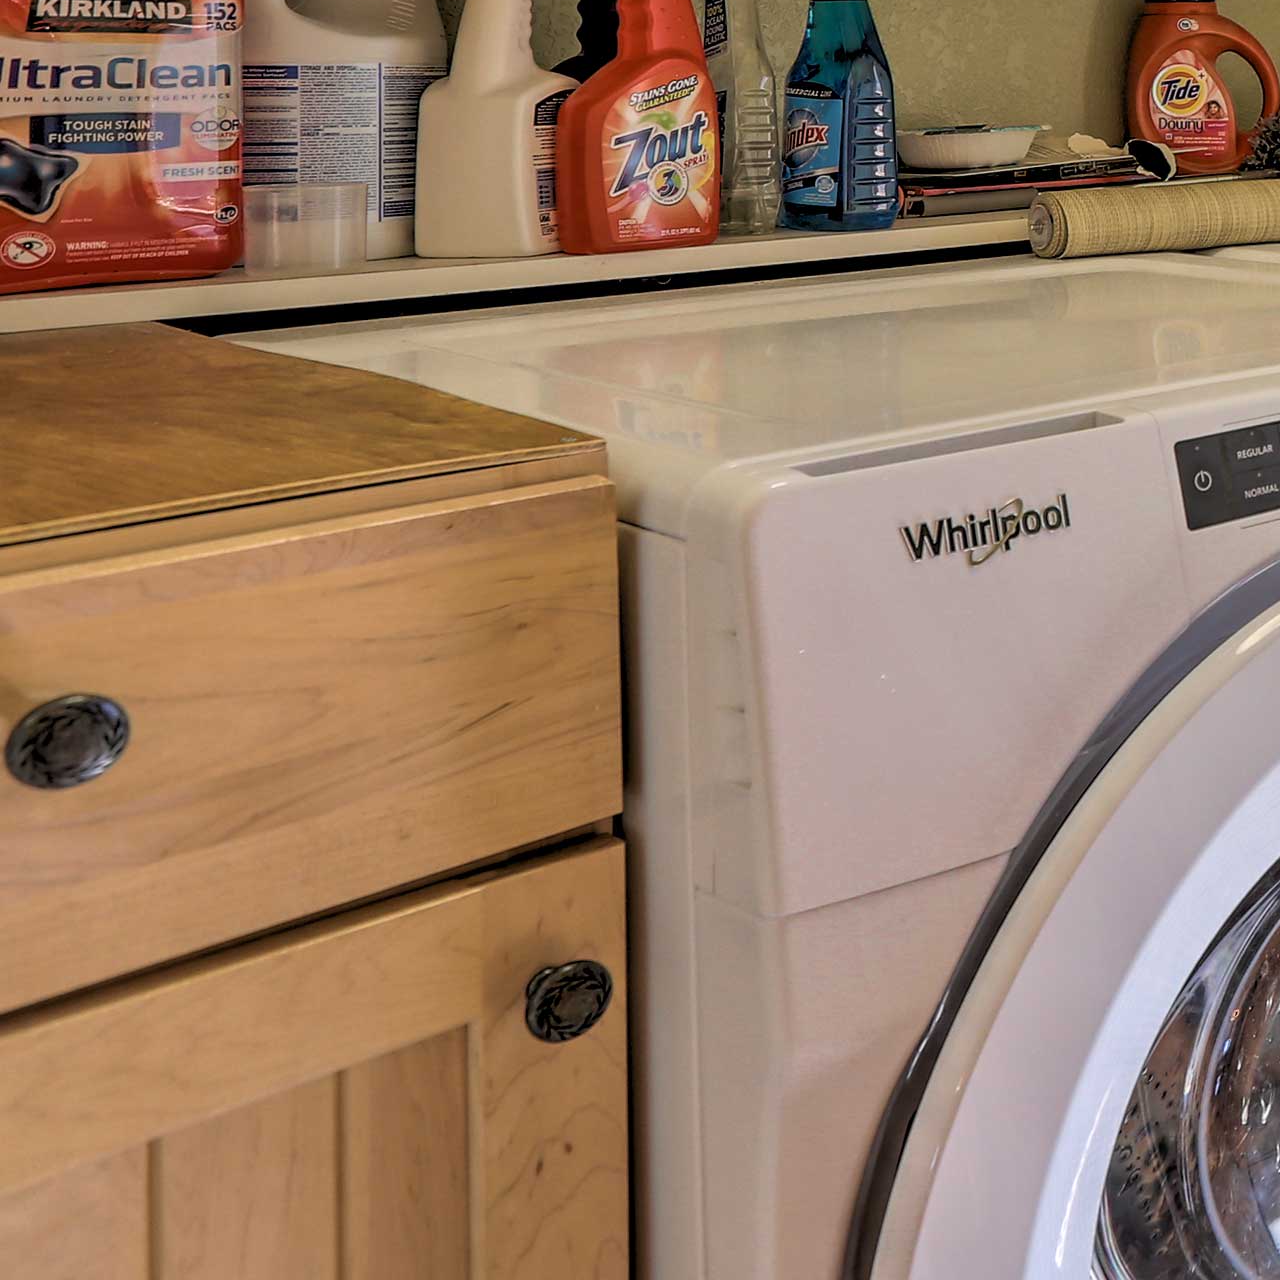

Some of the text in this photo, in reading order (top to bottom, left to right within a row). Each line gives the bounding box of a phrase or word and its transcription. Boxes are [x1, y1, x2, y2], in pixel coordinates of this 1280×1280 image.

[204, 3, 237, 20] 152
[206, 21, 237, 31] PACS
[0, 57, 232, 89] ltraClean
[119, 94, 196, 102] DETERGENT
[630, 86, 667, 105] STAINS
[1161, 78, 1200, 106] Tide
[64, 119, 151, 131] TOUGH STAIN
[1158, 117, 1204, 133] Downy
[49, 131, 164, 143] FIGHTING POWER
[611, 111, 708, 196] Zout
[162, 168, 205, 178] FRESH
[66, 241, 109, 250] WARNING:
[1237, 444, 1273, 460] REGULAR
[1244, 483, 1279, 499] NORMAL
[899, 494, 1071, 562] Whirlpool
